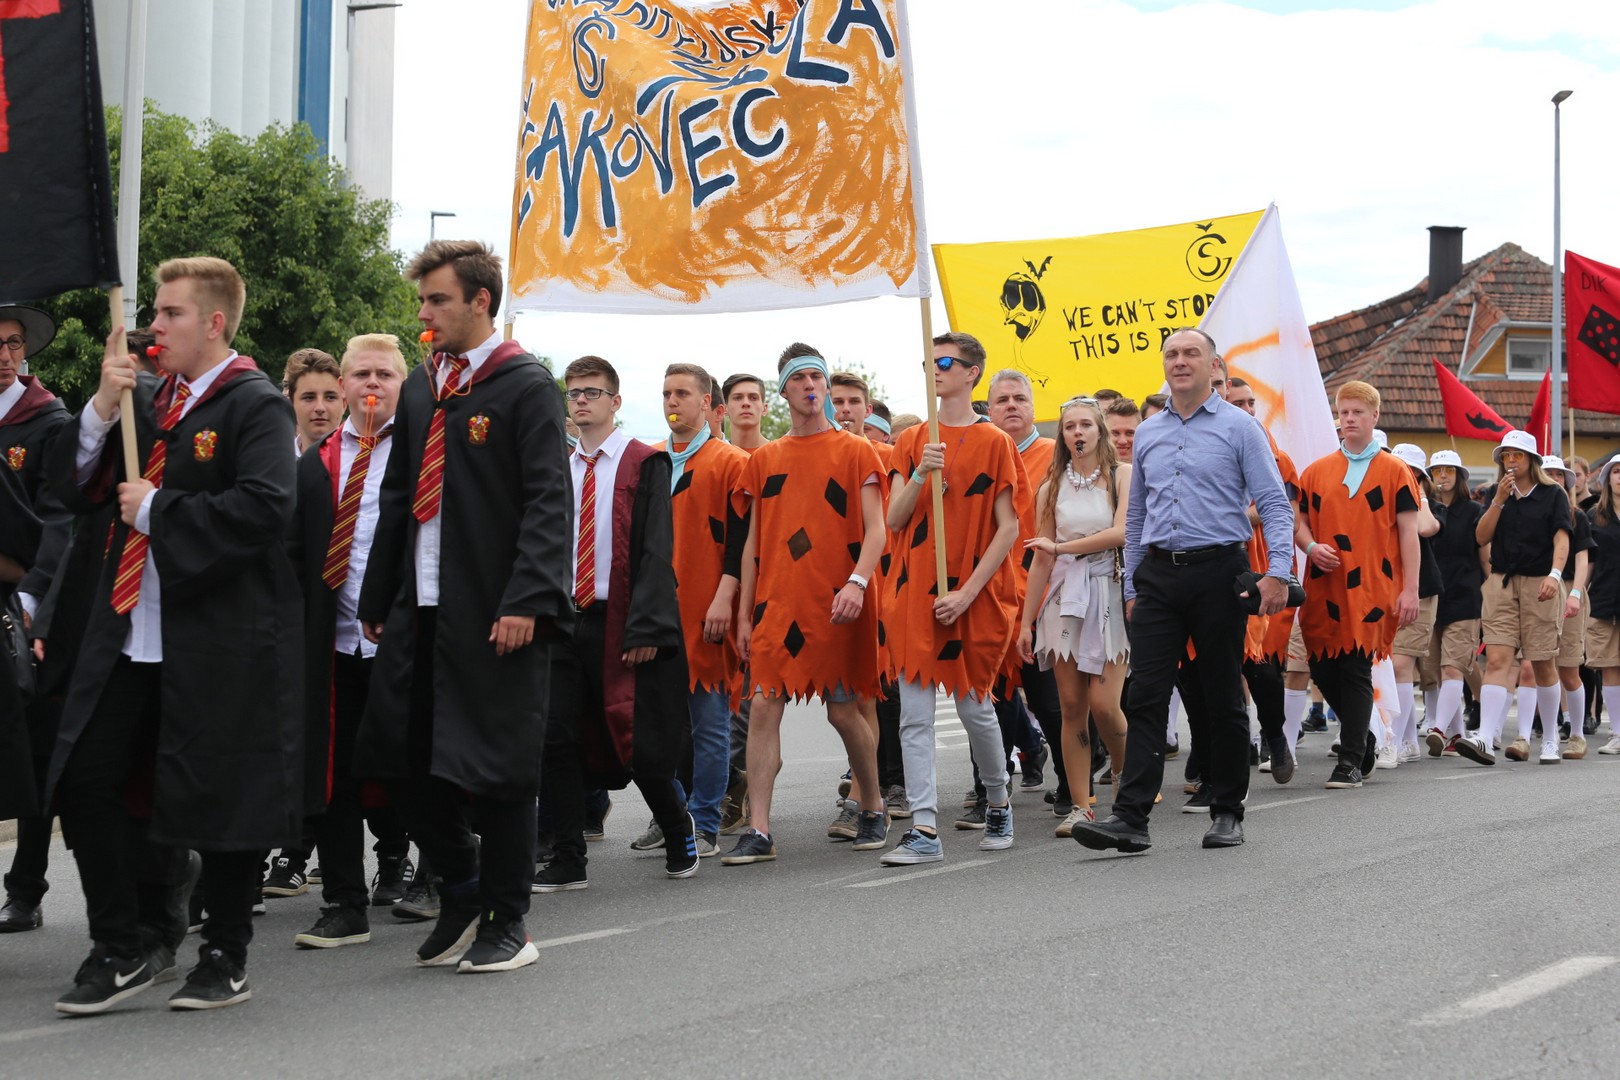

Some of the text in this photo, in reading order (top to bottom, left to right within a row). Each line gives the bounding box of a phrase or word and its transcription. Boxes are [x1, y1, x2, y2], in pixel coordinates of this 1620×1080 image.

[1581, 271, 1609, 295] DIK
[1062, 306, 1093, 332] WE
[1102, 298, 1156, 326] CAN'T
[1069, 332, 1120, 361] THIS
[1129, 331, 1149, 353] IS
